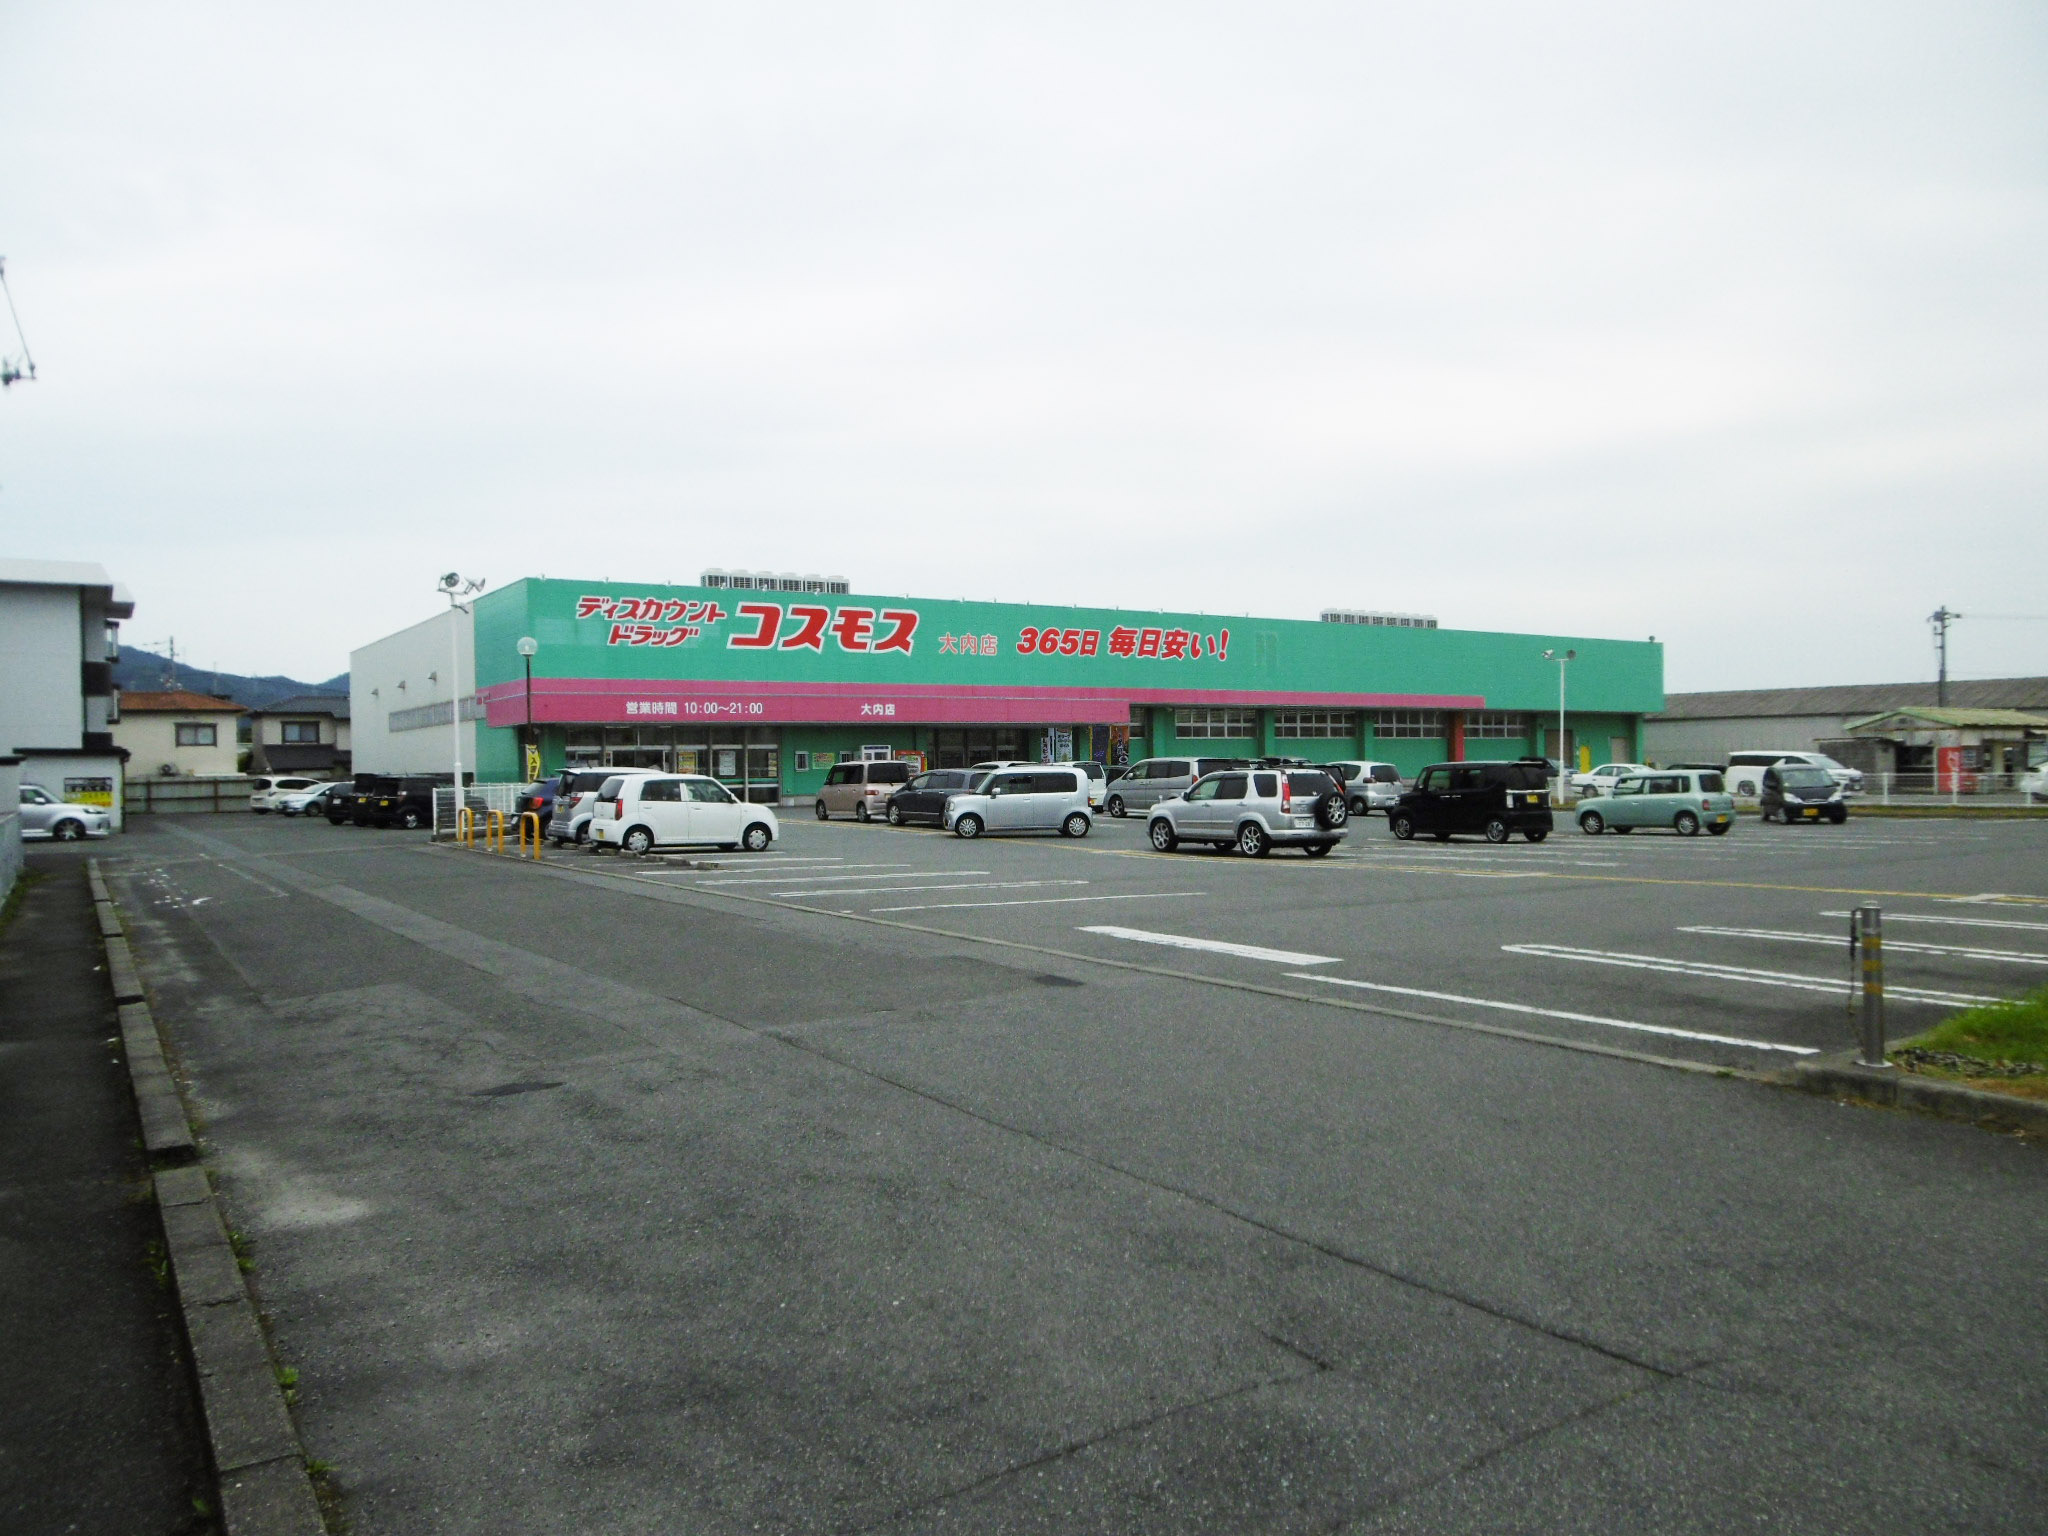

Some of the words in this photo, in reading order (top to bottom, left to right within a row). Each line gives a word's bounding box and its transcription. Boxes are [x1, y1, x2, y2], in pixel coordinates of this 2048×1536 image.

[577, 596, 727, 624] ディスカウント
[608, 625, 699, 647] ドラッグ
[728, 602, 919, 656] コスモス
[938, 633, 998, 656] 大内店
[1017, 627, 1101, 656] 365日
[626, 701, 677, 716] 営業時間
[861, 703, 896, 716] 大内店
